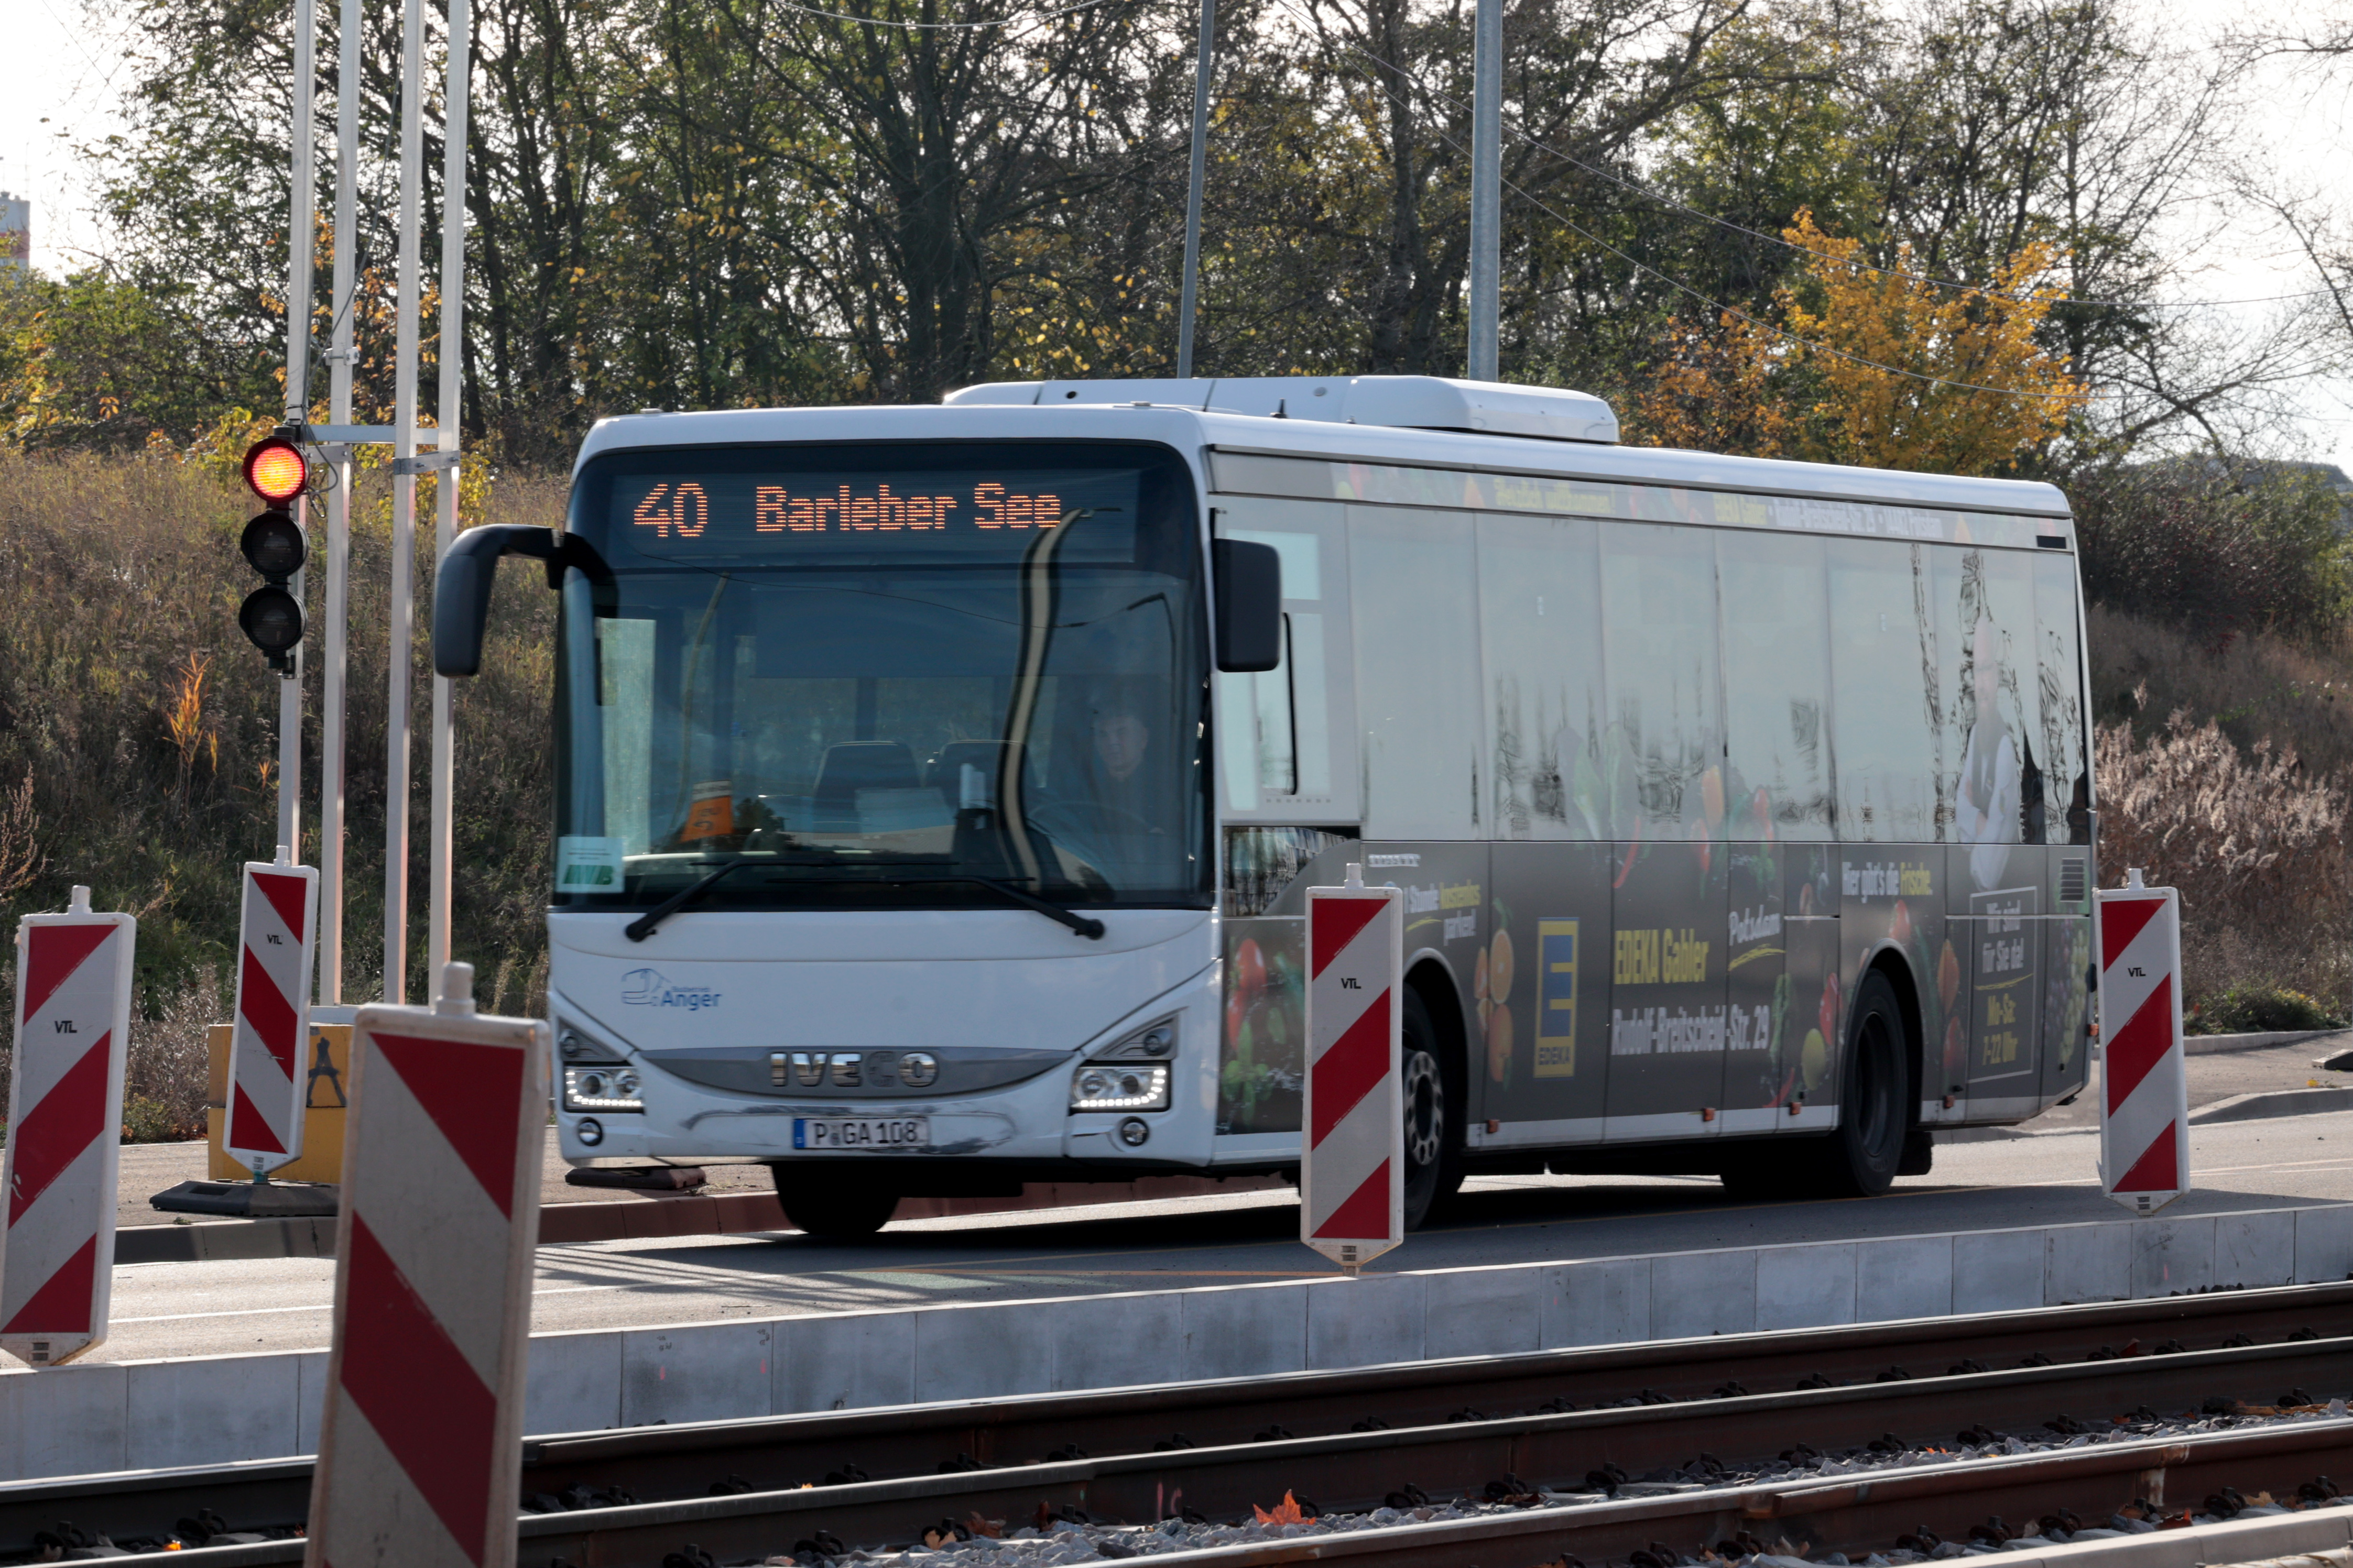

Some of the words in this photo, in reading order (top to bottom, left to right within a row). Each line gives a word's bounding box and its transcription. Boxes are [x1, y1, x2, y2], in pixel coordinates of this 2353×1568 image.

[634, 483, 708, 538] 40
[756, 484, 957, 532] Barleber
[974, 483, 1061, 529] See
[1886, 862, 1900, 895] die
[1409, 884, 1440, 913] Stunde
[267, 934, 282, 945] VTL
[1444, 908, 1477, 946] parken!
[1728, 904, 1781, 946] Potsdam
[1614, 929, 1660, 984] EDEKA
[1662, 928, 1709, 983] Gabler
[1996, 940, 2010, 972] Sie
[2010, 937, 2024, 970] da!
[1341, 978, 1361, 989] VTL
[2128, 968, 2146, 977] VTL
[661, 990, 722, 1011] Anger
[54, 1020, 78, 1034] VTL
[1753, 1005, 1770, 1049] 29
[1539, 1046, 1571, 1065] EDEKA
[814, 1123, 828, 1145] P
